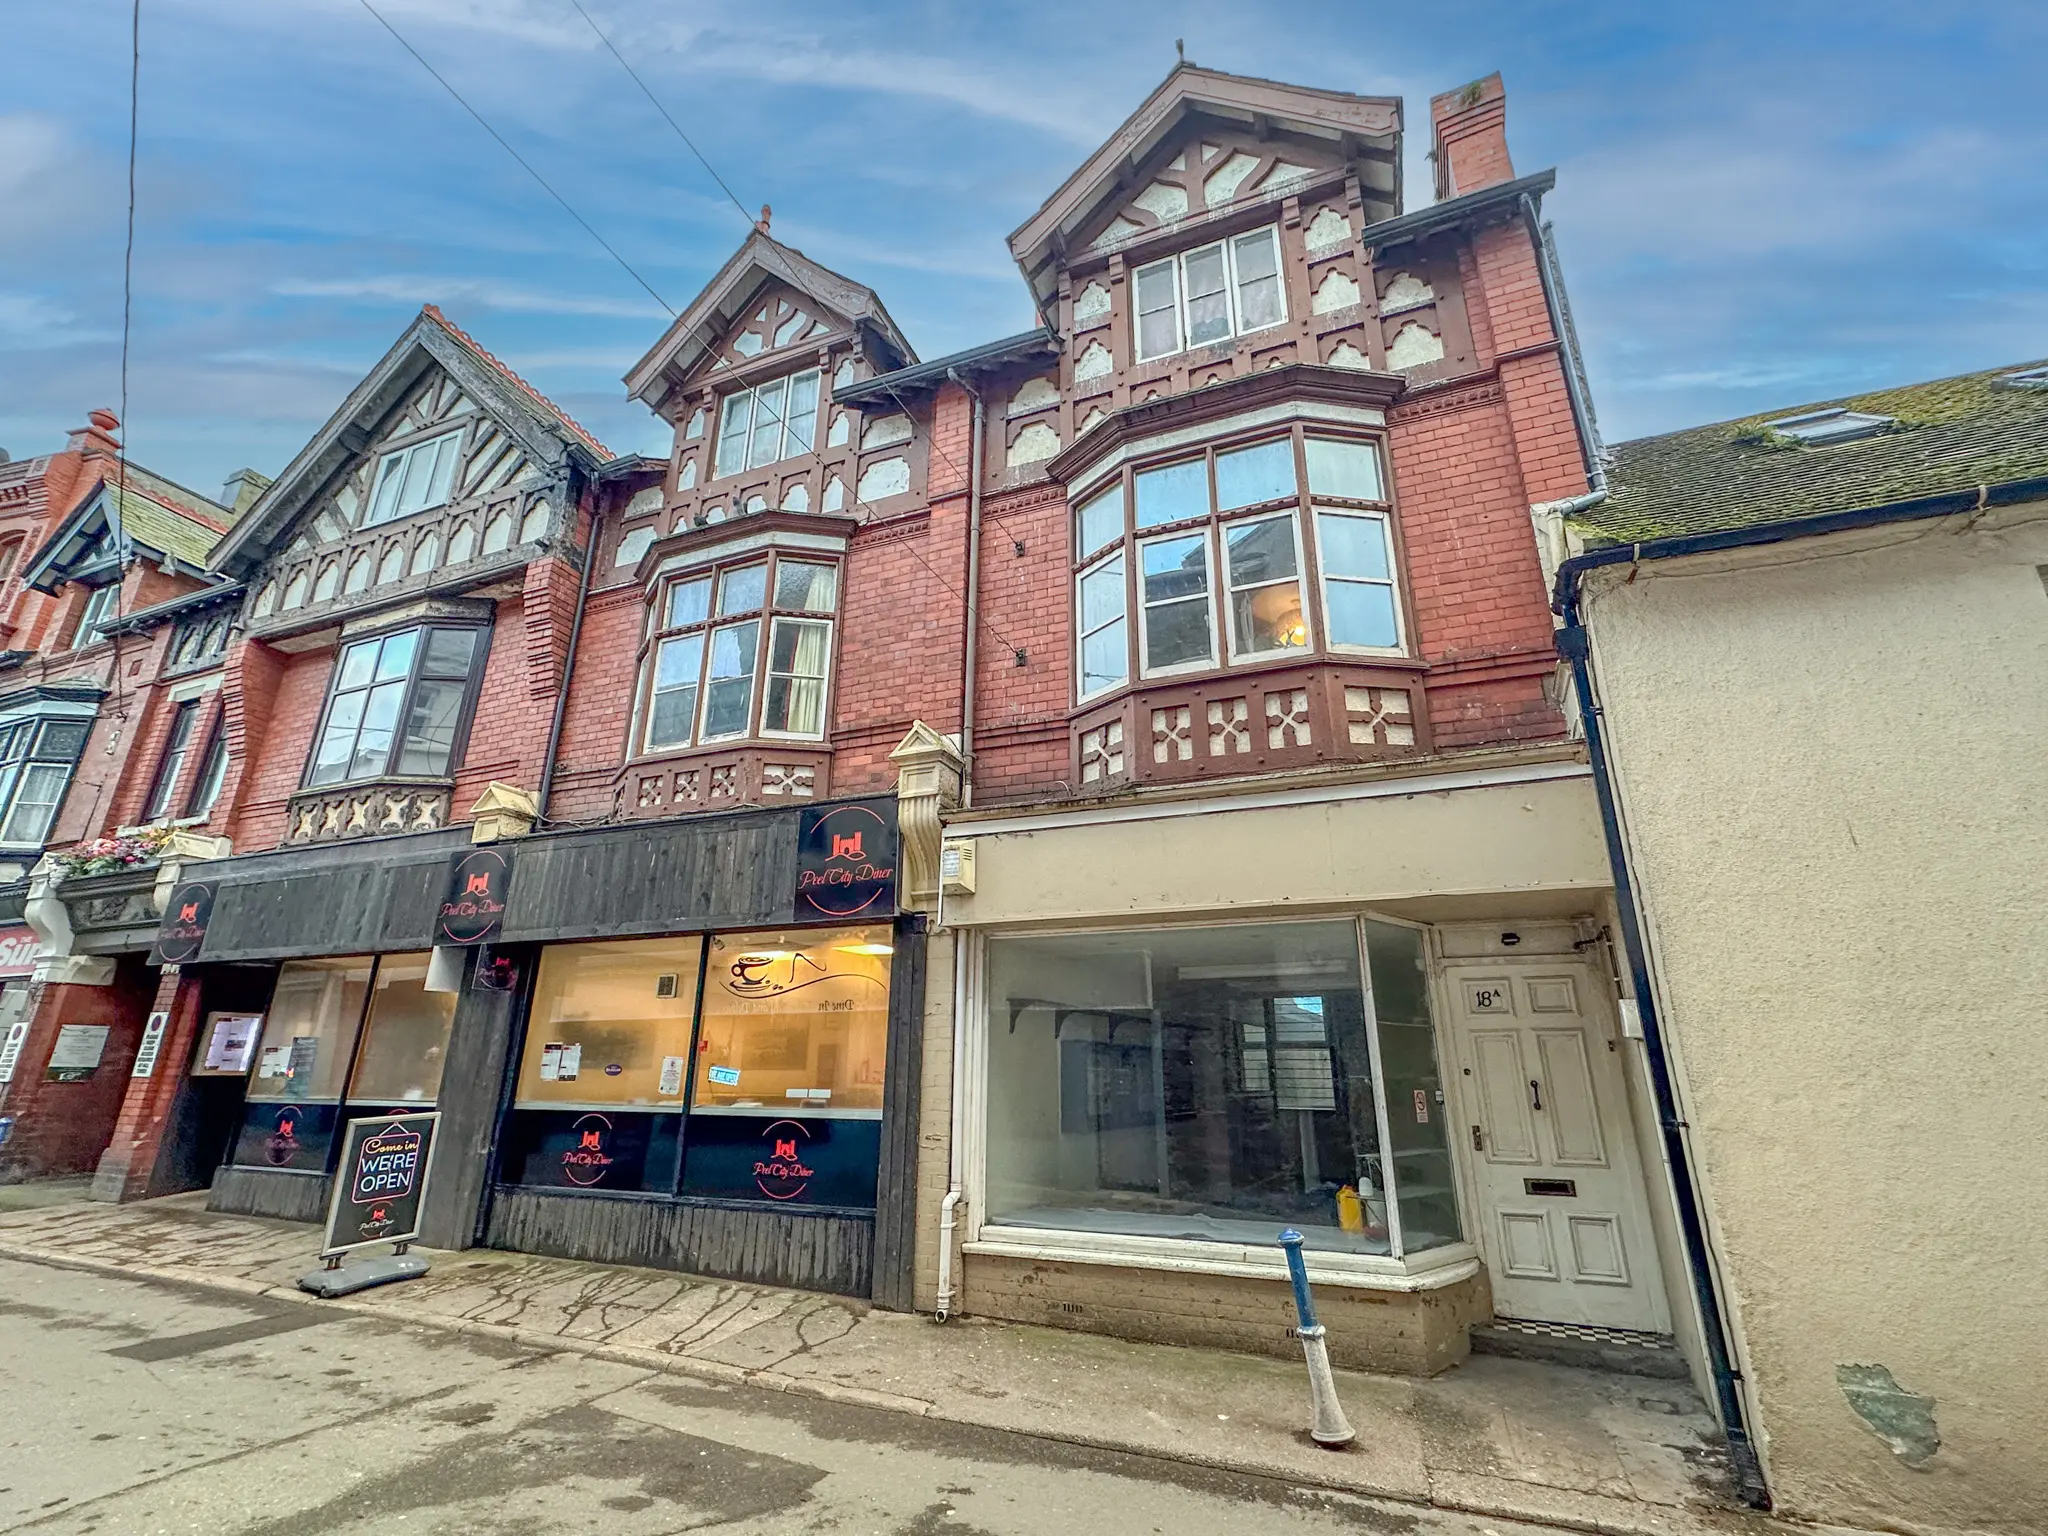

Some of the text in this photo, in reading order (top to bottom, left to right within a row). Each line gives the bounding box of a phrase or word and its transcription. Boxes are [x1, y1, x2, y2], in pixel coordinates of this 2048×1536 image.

[797, 864, 893, 889] Peel City Diner
[1476, 989, 1501, 1007] 18A
[365, 1139, 418, 1154] Come in
[361, 1152, 417, 1173] WE'RE
[360, 1171, 411, 1192] OPEN
